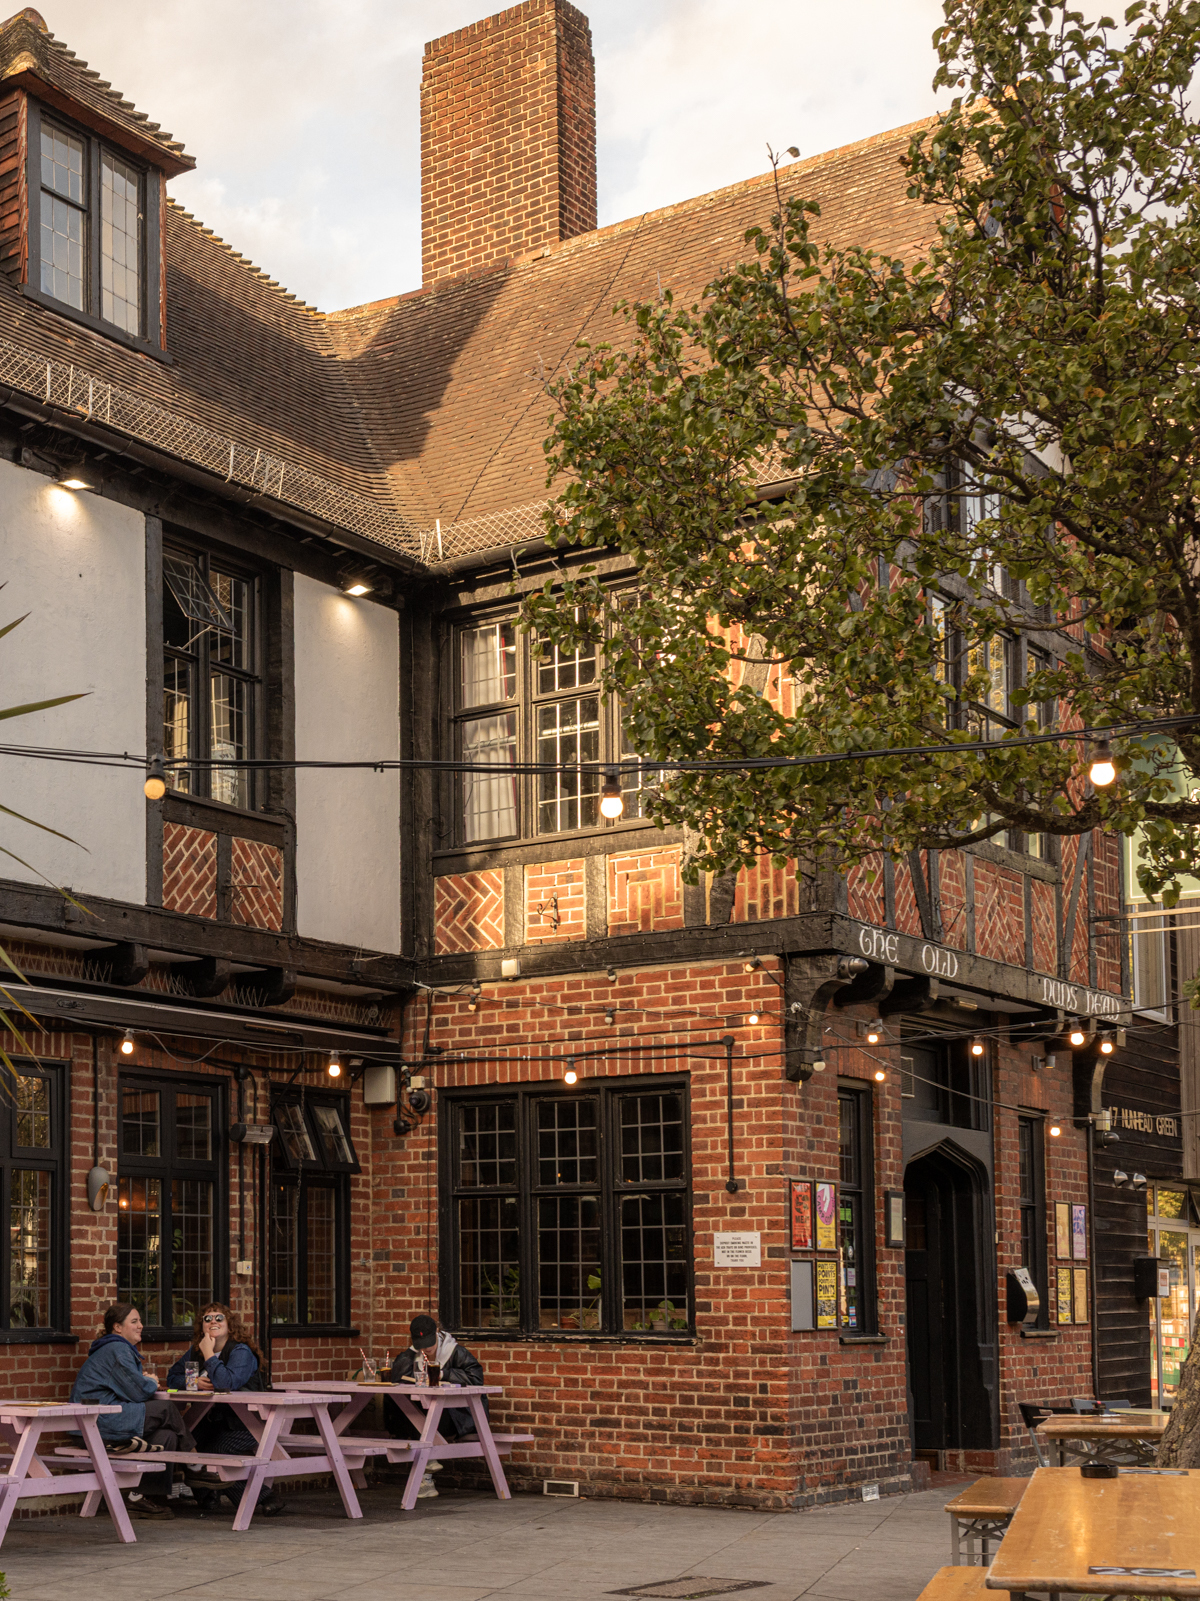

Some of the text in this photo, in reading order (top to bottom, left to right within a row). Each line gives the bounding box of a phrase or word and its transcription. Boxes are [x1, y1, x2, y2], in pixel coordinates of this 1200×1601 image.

[921, 944, 959, 978] OLD
[1121, 1107, 1153, 1133] NUNHEAD
[1155, 1117, 1178, 1137] GREEN
